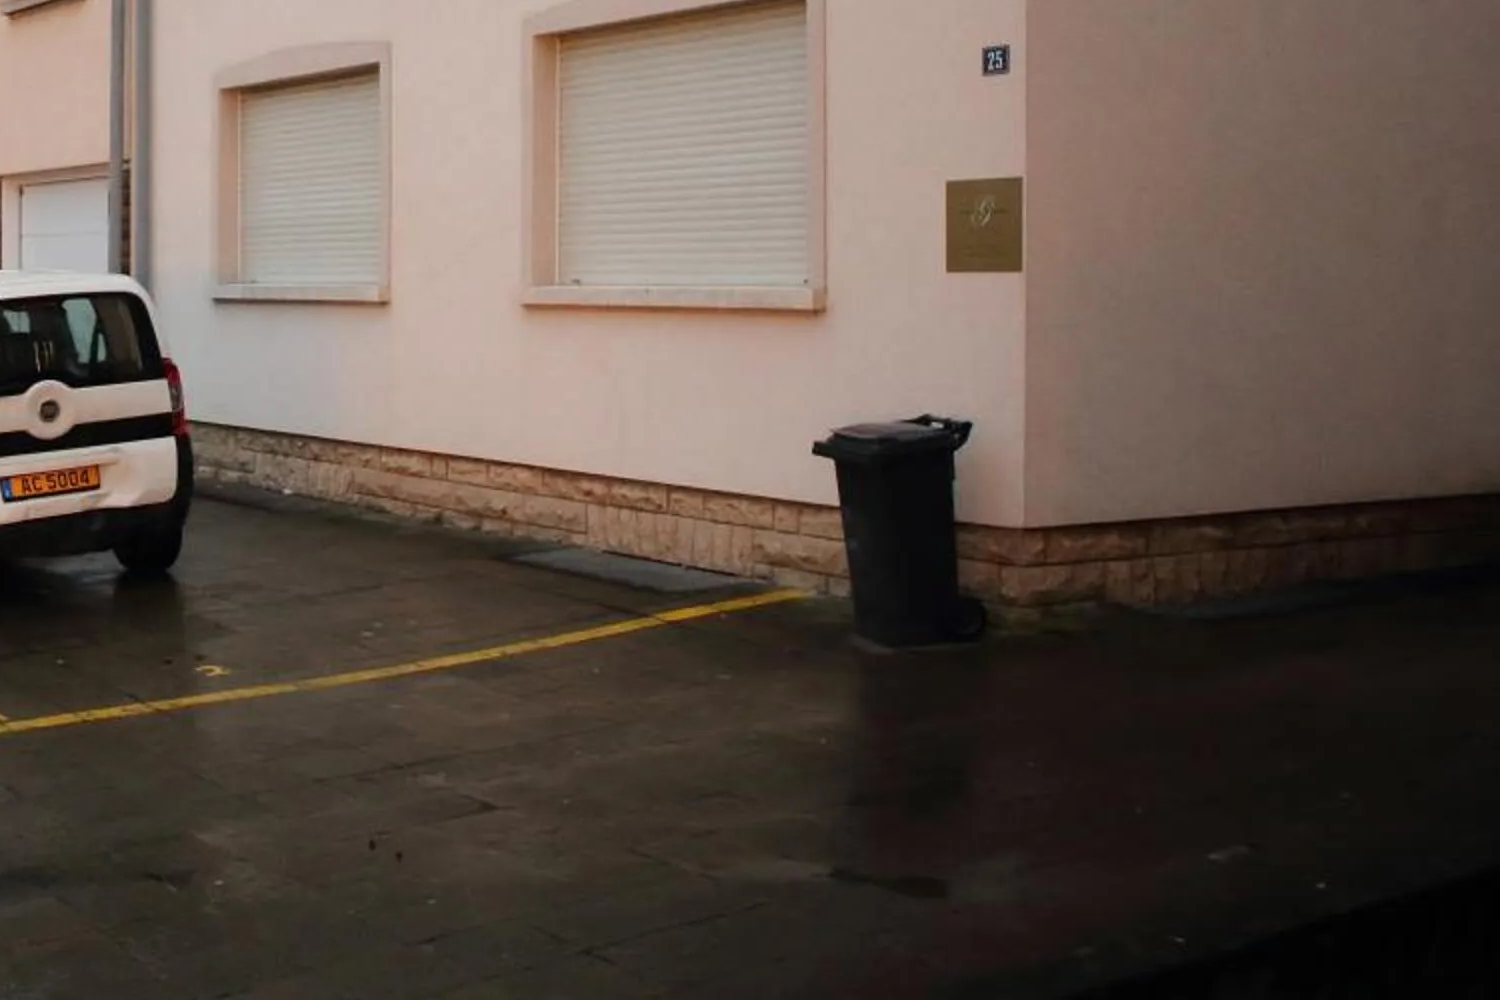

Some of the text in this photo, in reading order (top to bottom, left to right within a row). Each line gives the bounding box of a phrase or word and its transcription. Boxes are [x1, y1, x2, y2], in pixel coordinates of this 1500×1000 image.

[987, 50, 1004, 71] 25
[21, 468, 89, 493] AC 5004
